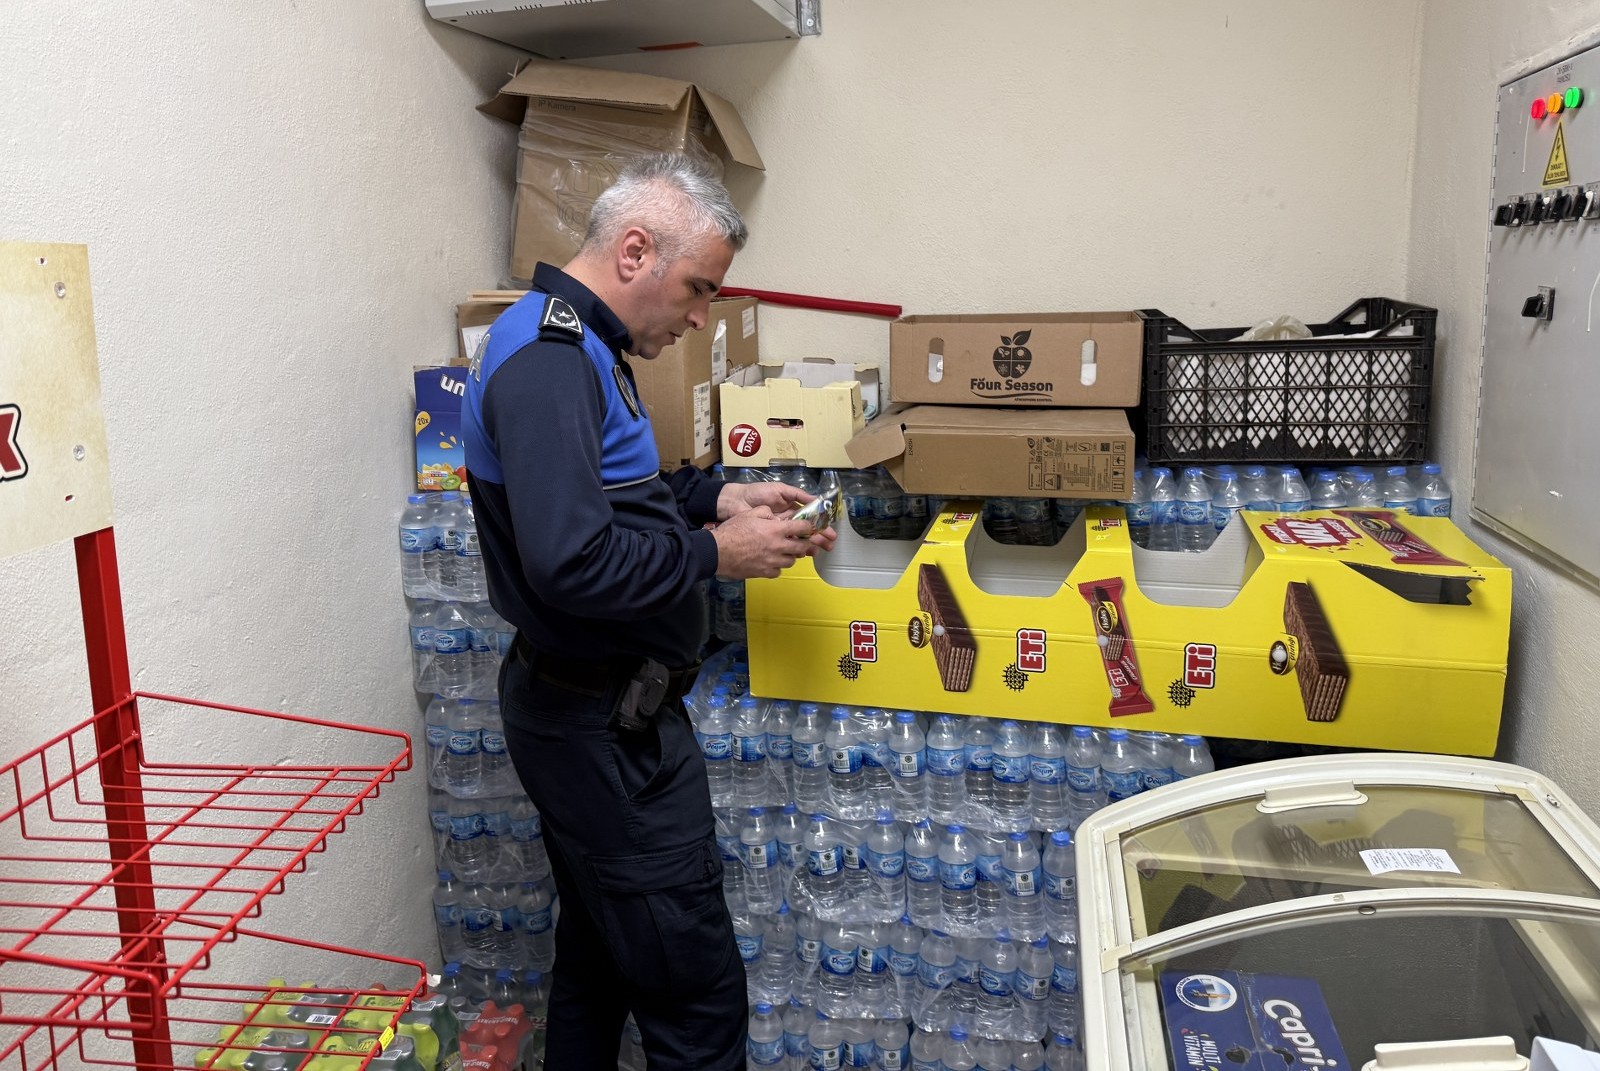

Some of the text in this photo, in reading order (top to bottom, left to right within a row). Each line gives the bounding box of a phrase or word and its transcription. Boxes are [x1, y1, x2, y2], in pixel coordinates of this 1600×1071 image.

[440, 374, 466, 397] un
[1005, 379, 1054, 392] Season
[732, 427, 759, 454] 7 DAYS
